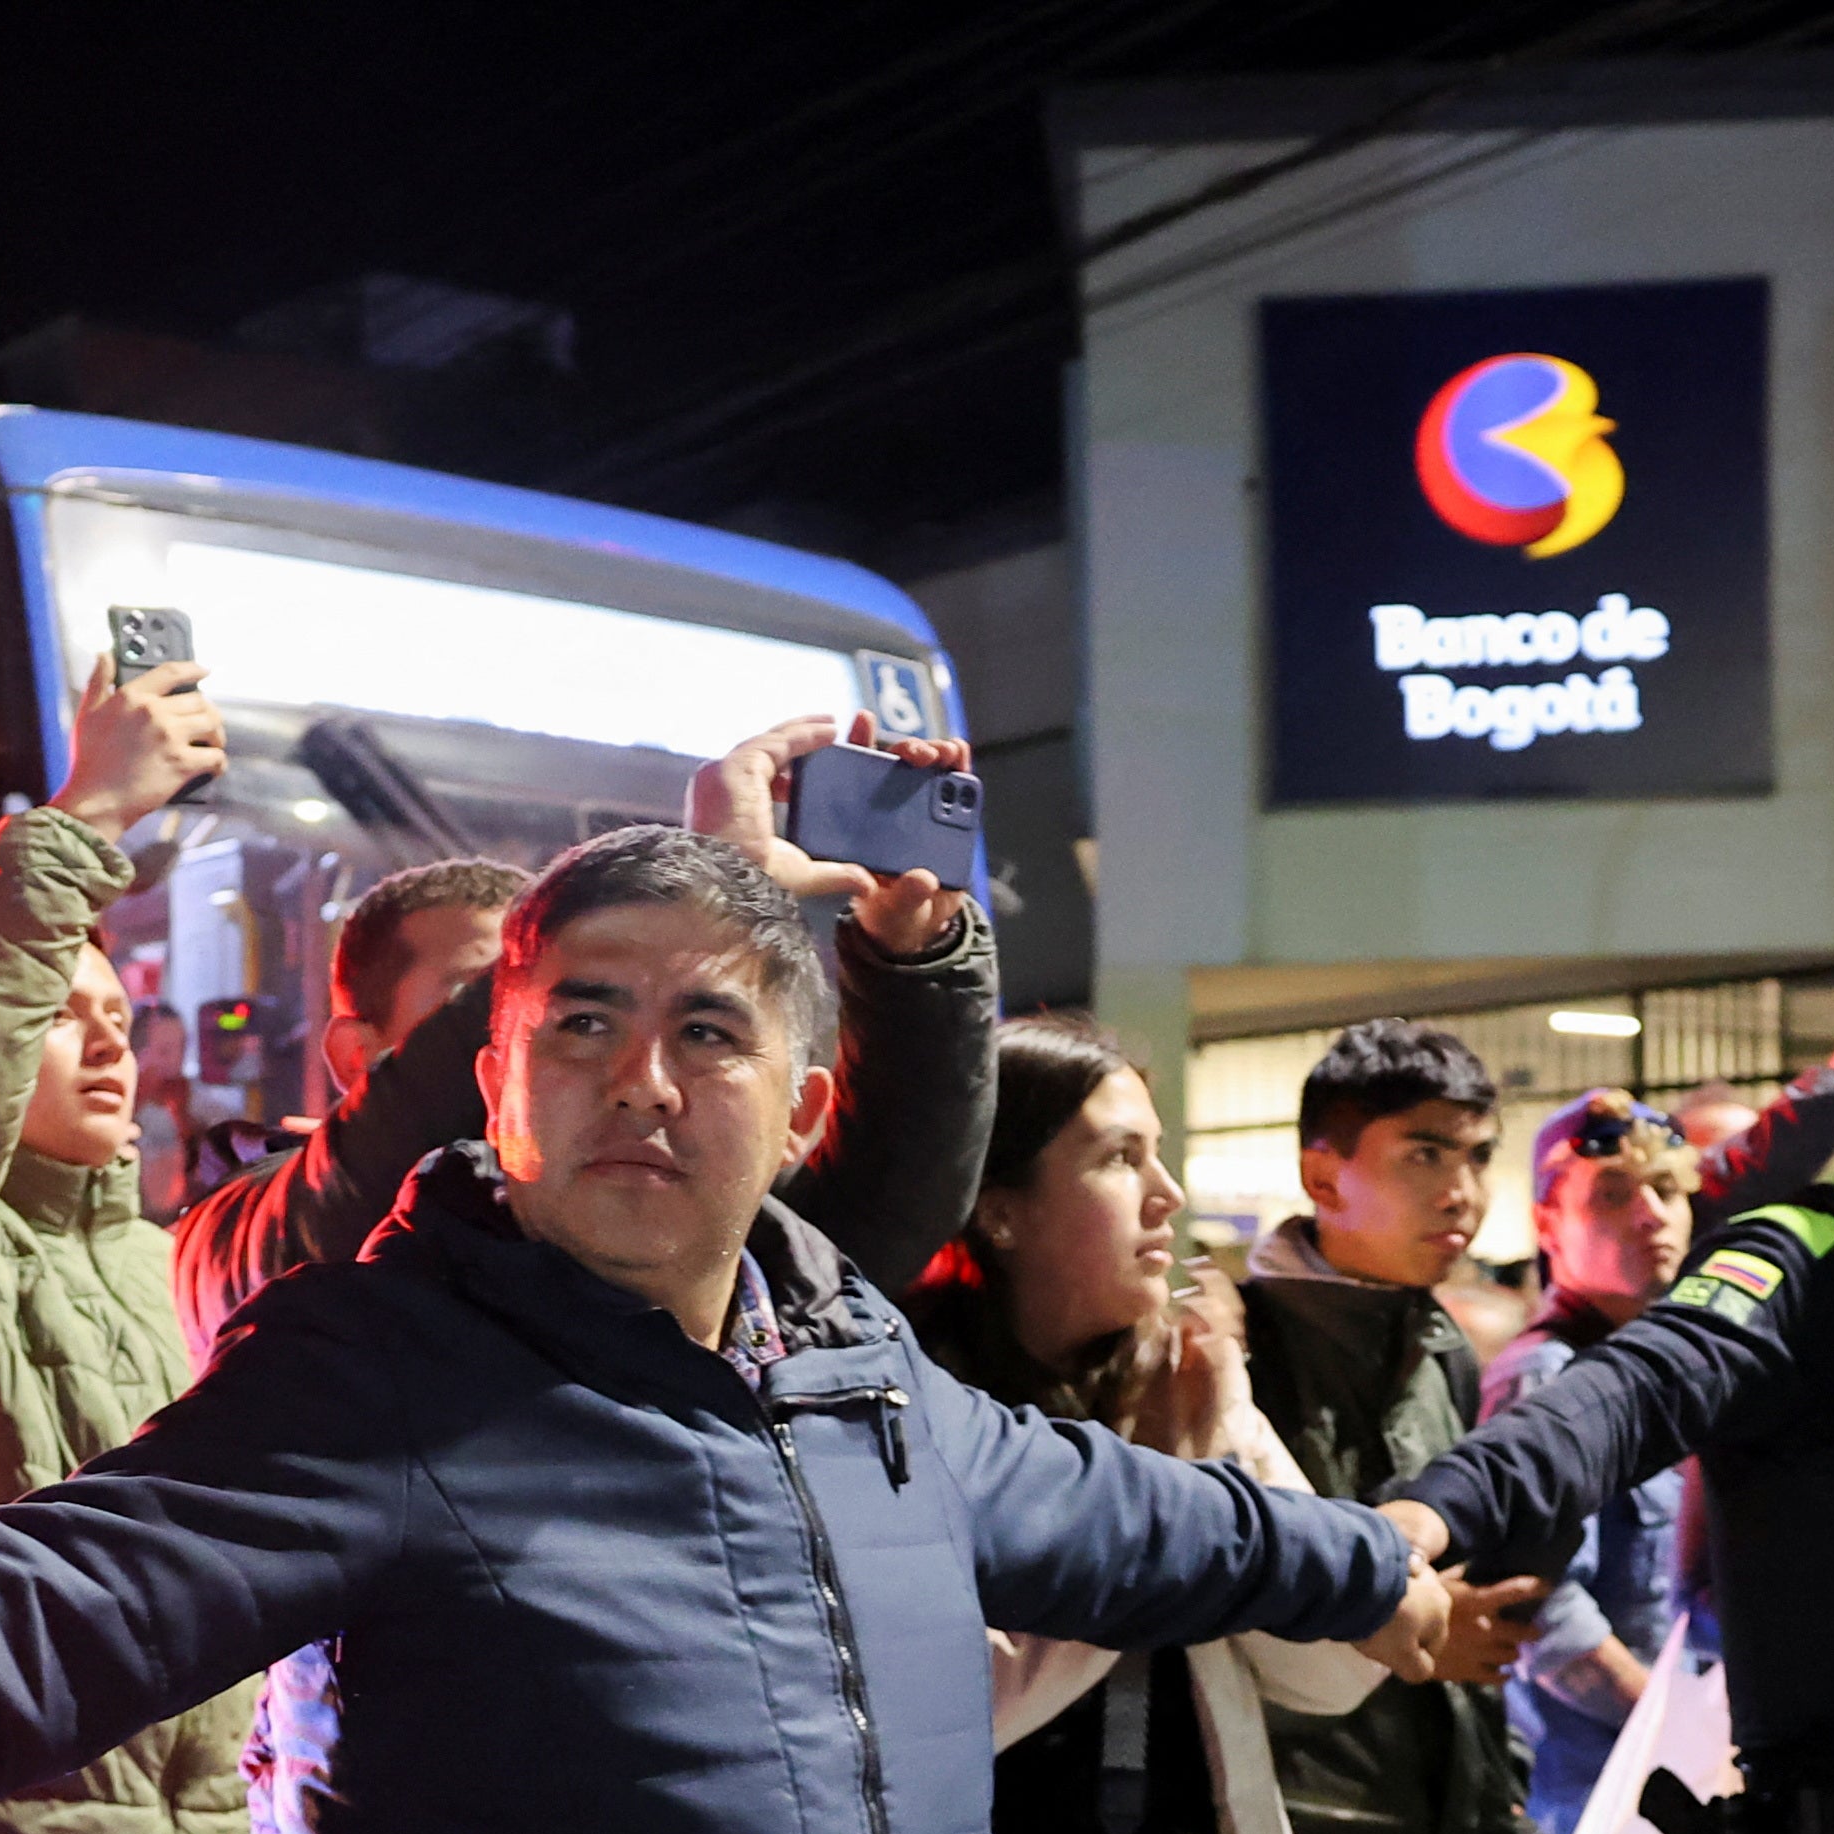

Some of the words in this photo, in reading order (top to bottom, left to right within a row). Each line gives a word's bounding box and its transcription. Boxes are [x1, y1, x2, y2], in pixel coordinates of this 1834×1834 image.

[1369, 603, 1580, 670] Banco
[1580, 593, 1670, 661] de
[1398, 665, 1643, 750] Bogotá
